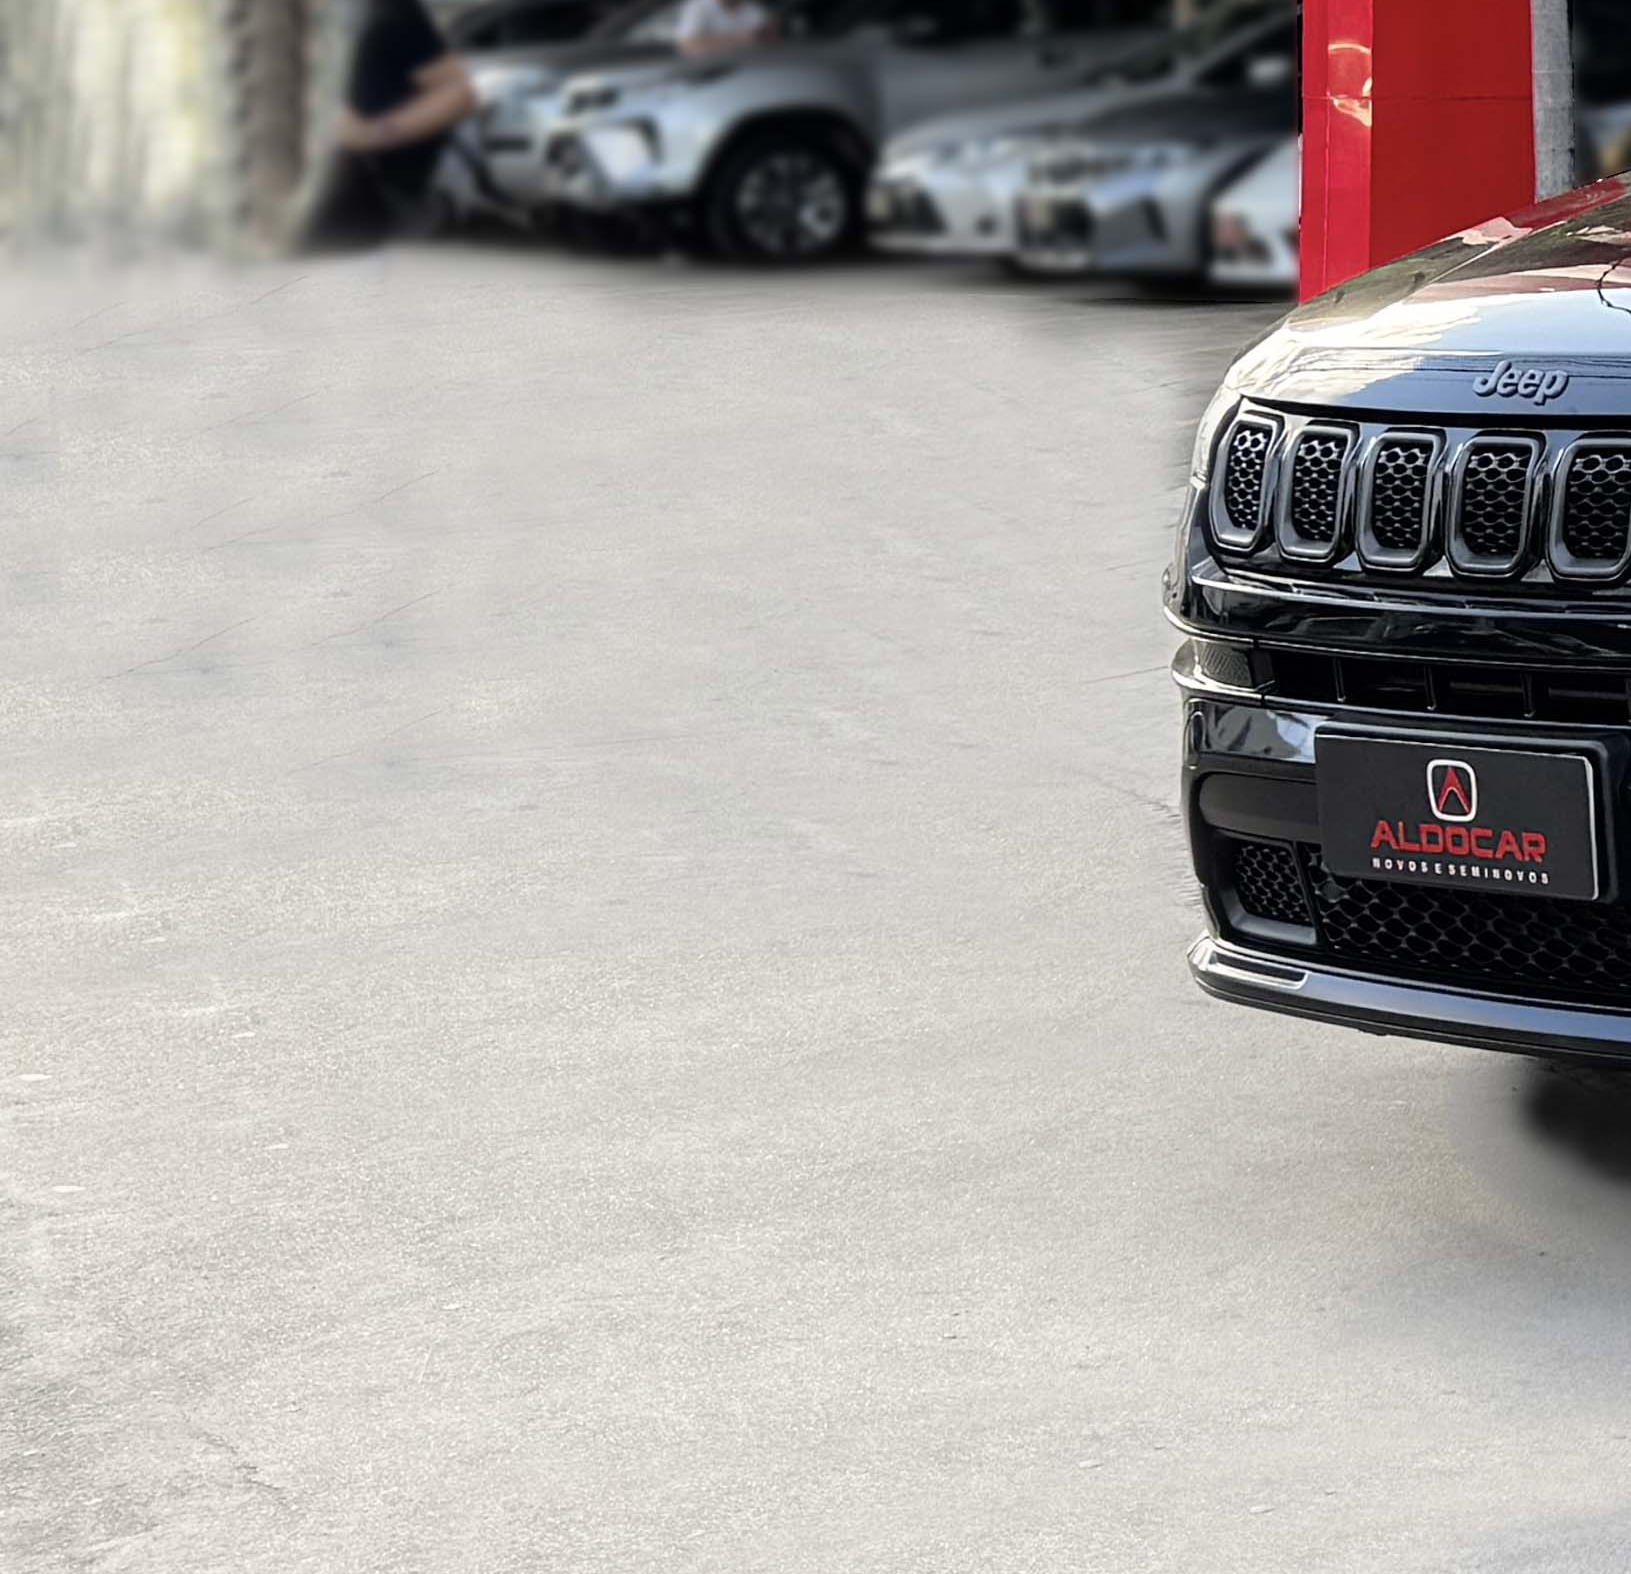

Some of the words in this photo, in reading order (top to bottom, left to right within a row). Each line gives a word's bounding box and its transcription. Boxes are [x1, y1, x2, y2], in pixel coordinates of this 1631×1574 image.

[1472, 360, 1570, 406] Jeep
[1370, 820, 1547, 863] ALDOCAR
[1372, 857, 1428, 873] NOVOS
[1434, 863, 1443, 875] E
[1448, 864, 1550, 885] SEMINOVOS
